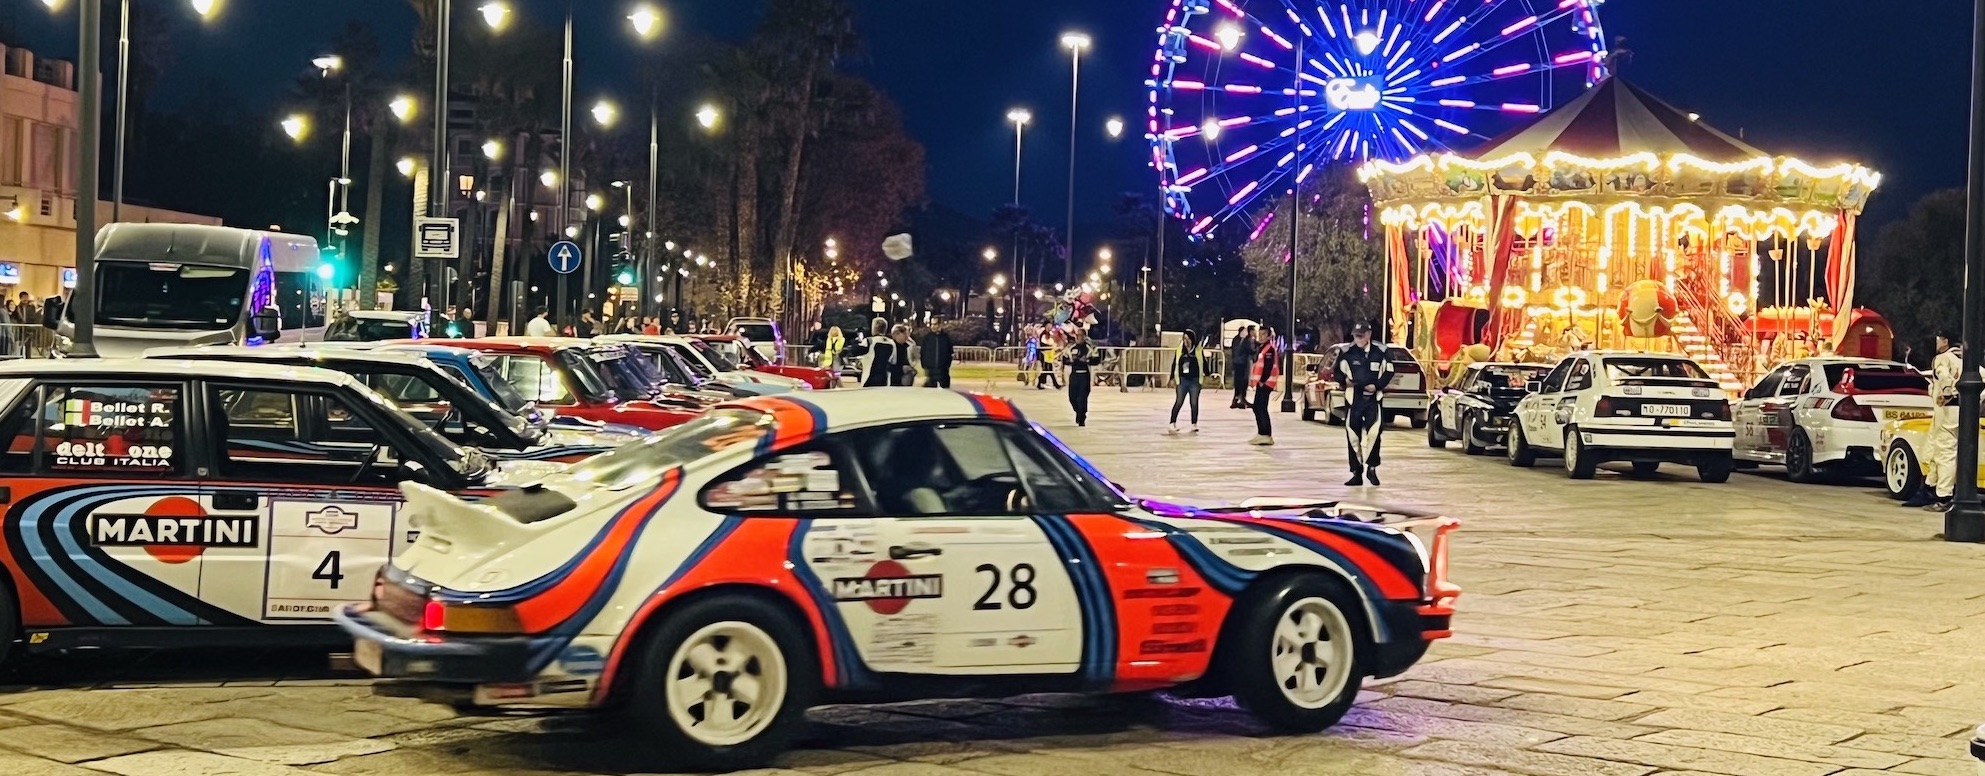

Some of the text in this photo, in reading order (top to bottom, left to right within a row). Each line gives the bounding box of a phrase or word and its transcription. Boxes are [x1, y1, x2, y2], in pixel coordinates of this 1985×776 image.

[151, 402, 170, 413] R.
[150, 416, 170, 427] A.
[128, 445, 173, 459] one
[56, 457, 170, 467] CLUB ITALIA
[97, 517, 252, 544] MARTINI
[312, 550, 344, 590] 4
[972, 562, 1038, 611] 28
